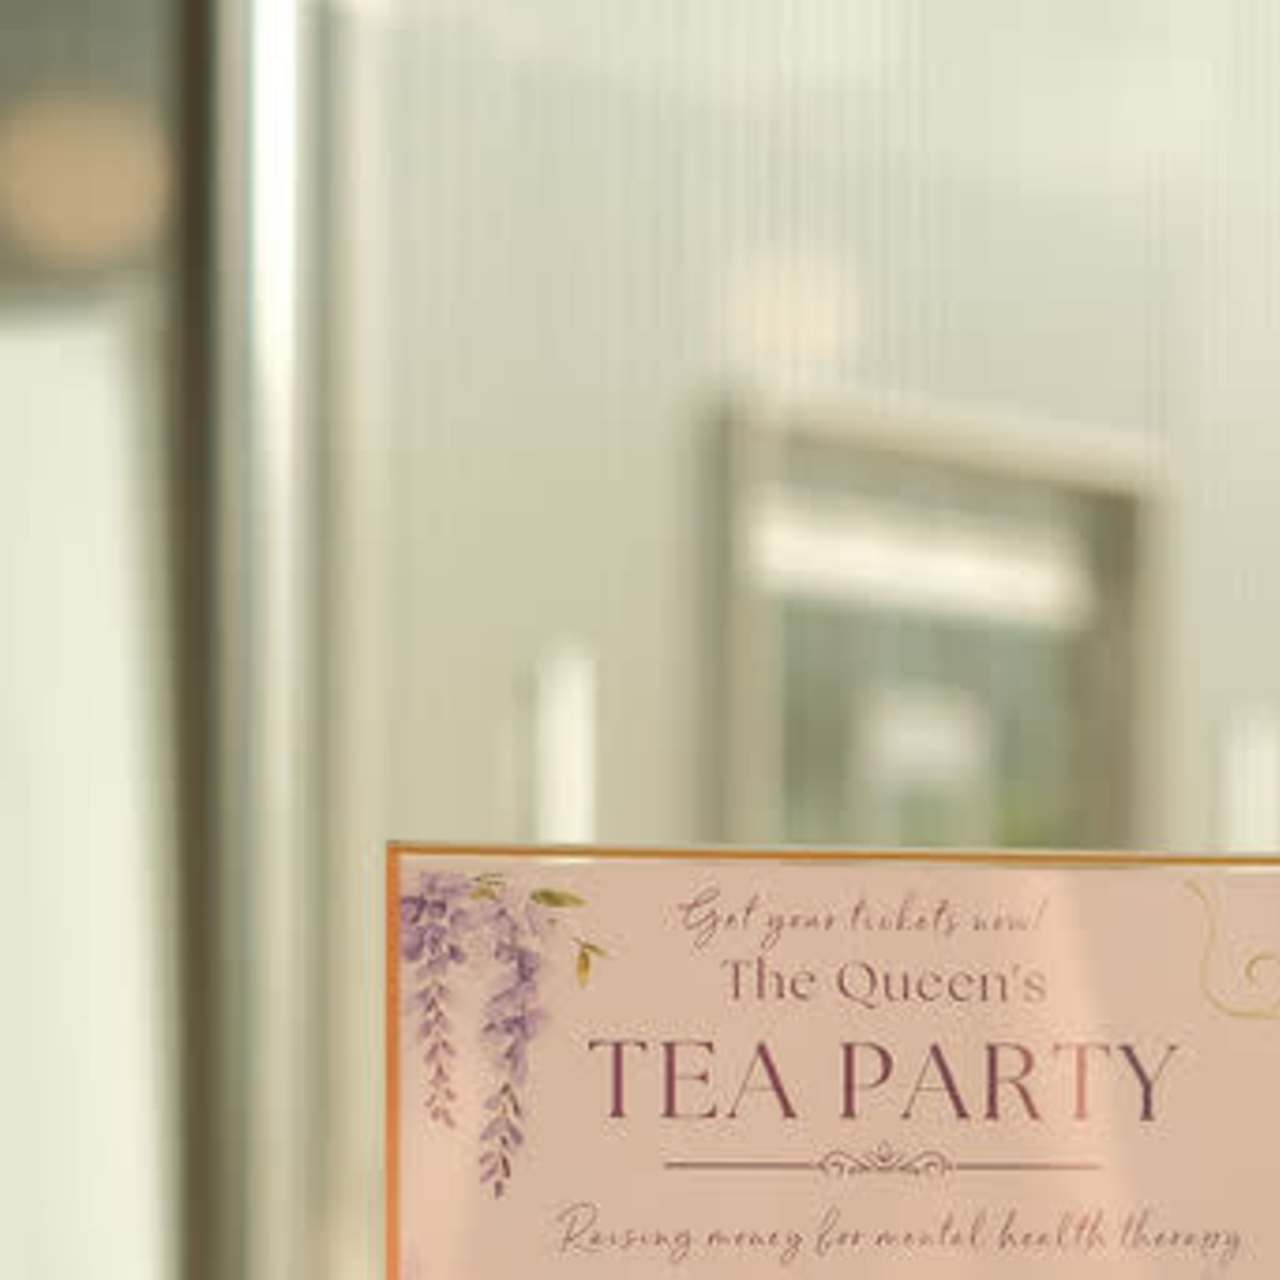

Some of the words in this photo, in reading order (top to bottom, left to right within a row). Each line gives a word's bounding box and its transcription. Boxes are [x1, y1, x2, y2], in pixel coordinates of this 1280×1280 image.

[678, 886, 760, 949] Get
[761, 910, 834, 950] your
[850, 896, 960, 936] tickets
[721, 956, 816, 1001] The
[837, 960, 1047, 1009] Queen's
[587, 1038, 797, 1121] TEA
[838, 1038, 1181, 1123] PARTY
[557, 1202, 693, 1263] Raising
[705, 1230, 804, 1265] money
[815, 1207, 866, 1261] for
[874, 1208, 981, 1250] mental
[998, 1208, 1105, 1250] health
[1120, 1207, 1243, 1263] therapy
